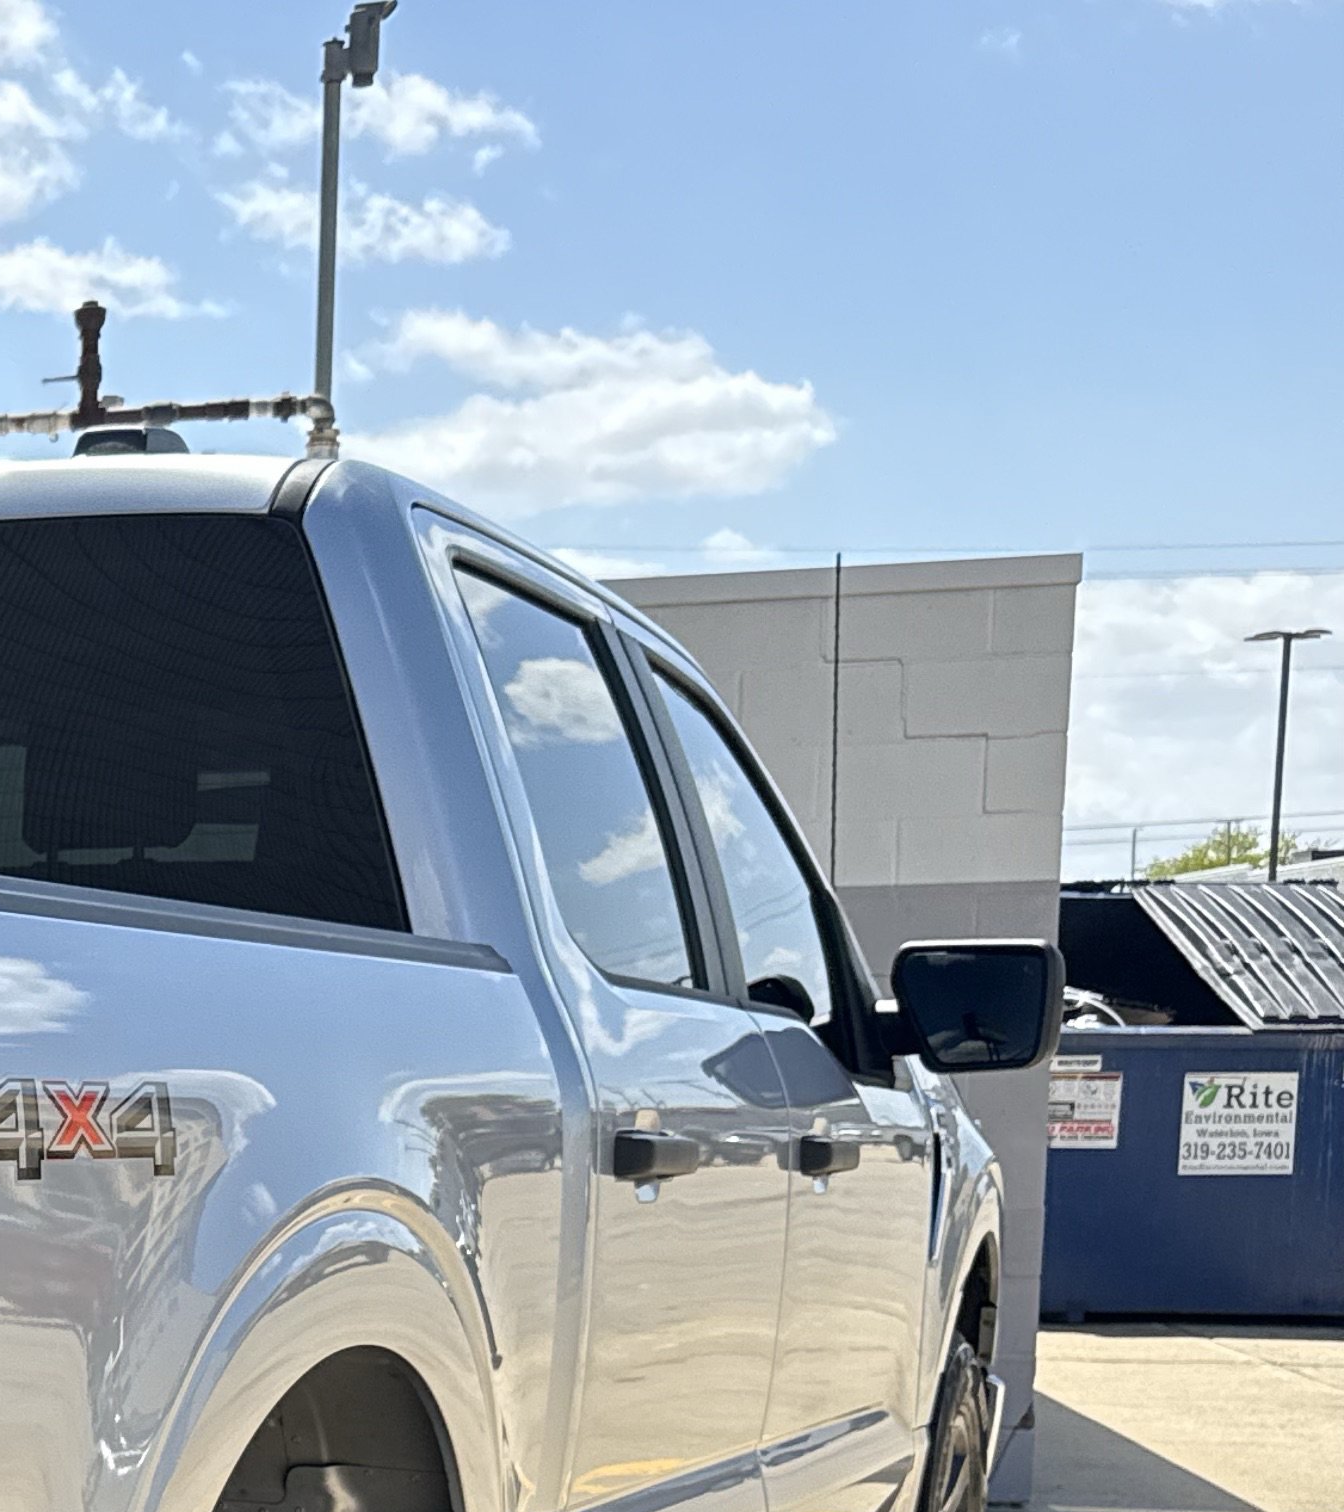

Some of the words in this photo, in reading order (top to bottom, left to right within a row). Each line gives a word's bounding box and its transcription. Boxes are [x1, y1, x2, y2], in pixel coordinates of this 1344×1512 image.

[1223, 1083, 1294, 1109] Rite
[1184, 1110, 1293, 1124] Environmental
[1253, 1127, 1280, 1138] Iowa
[1182, 1141, 1290, 1160] 319-235-7401
